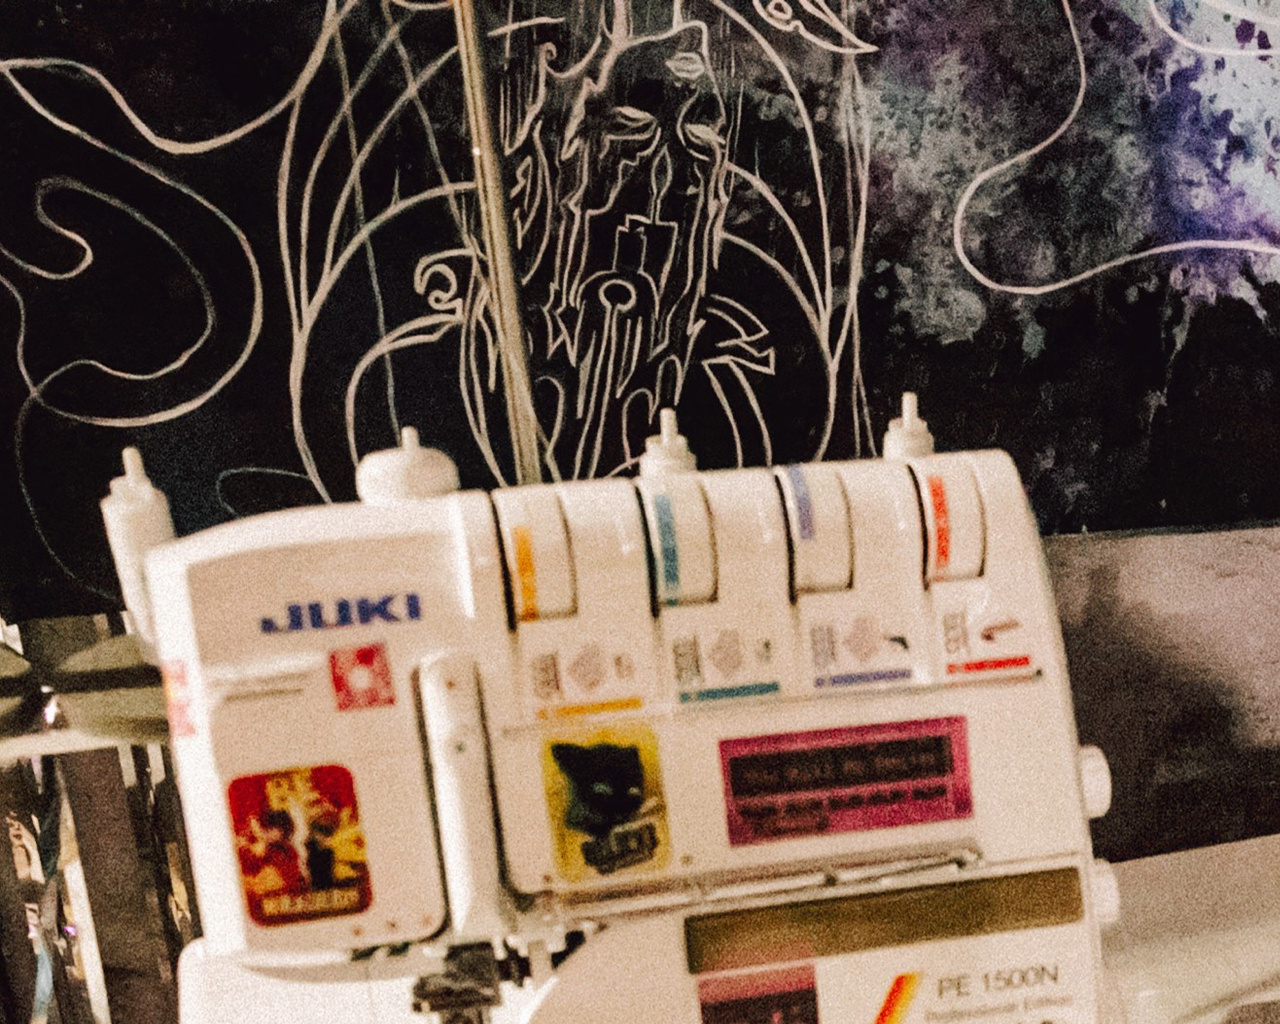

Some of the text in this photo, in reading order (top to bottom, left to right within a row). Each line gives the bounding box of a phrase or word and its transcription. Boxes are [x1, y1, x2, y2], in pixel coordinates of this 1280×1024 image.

[260, 593, 421, 633] JUKI
[937, 965, 1060, 999] PE 1500N
